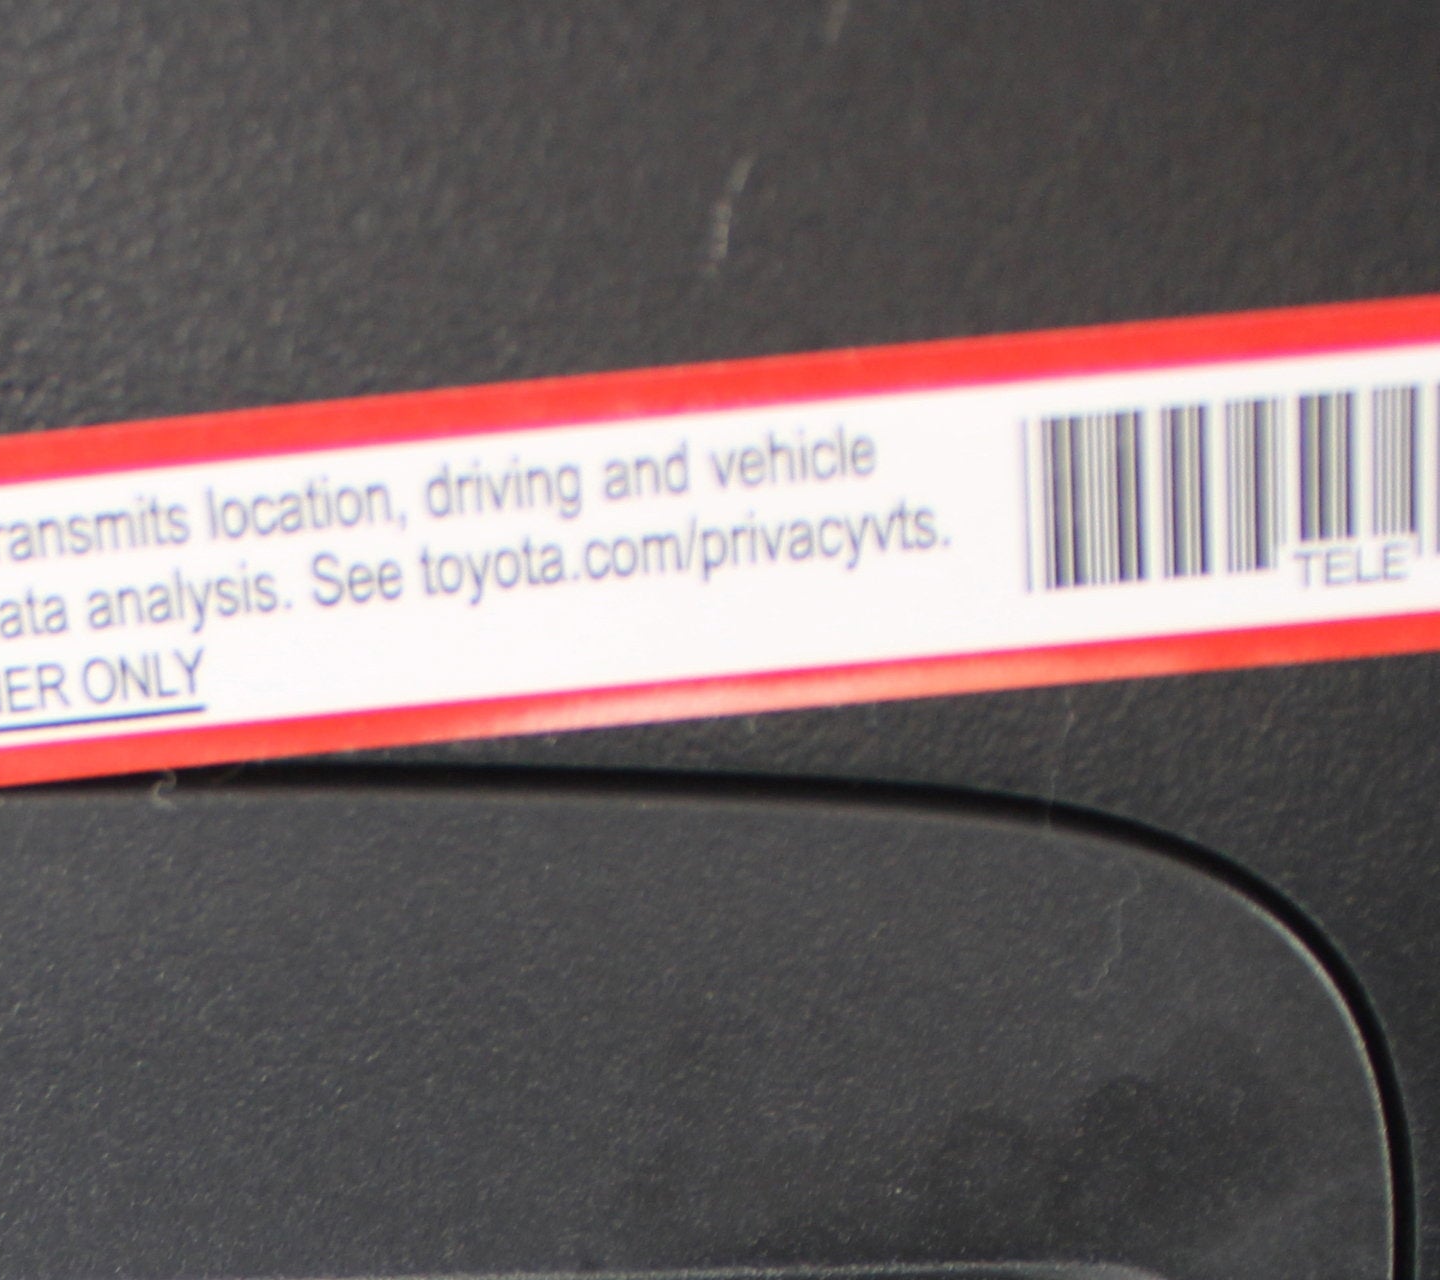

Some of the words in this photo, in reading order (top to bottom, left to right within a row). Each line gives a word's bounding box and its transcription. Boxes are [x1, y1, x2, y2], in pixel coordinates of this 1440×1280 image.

[205, 475, 408, 541] location,
[426, 456, 583, 519] driving
[602, 441, 689, 501] and
[709, 424, 876, 490] vehicle
[86, 563, 293, 637] analysis.
[309, 553, 404, 607] See
[419, 503, 952, 602] toyota.com/privacyvts.
[1294, 544, 1409, 588] TELE
[80, 649, 207, 706] ONLY
